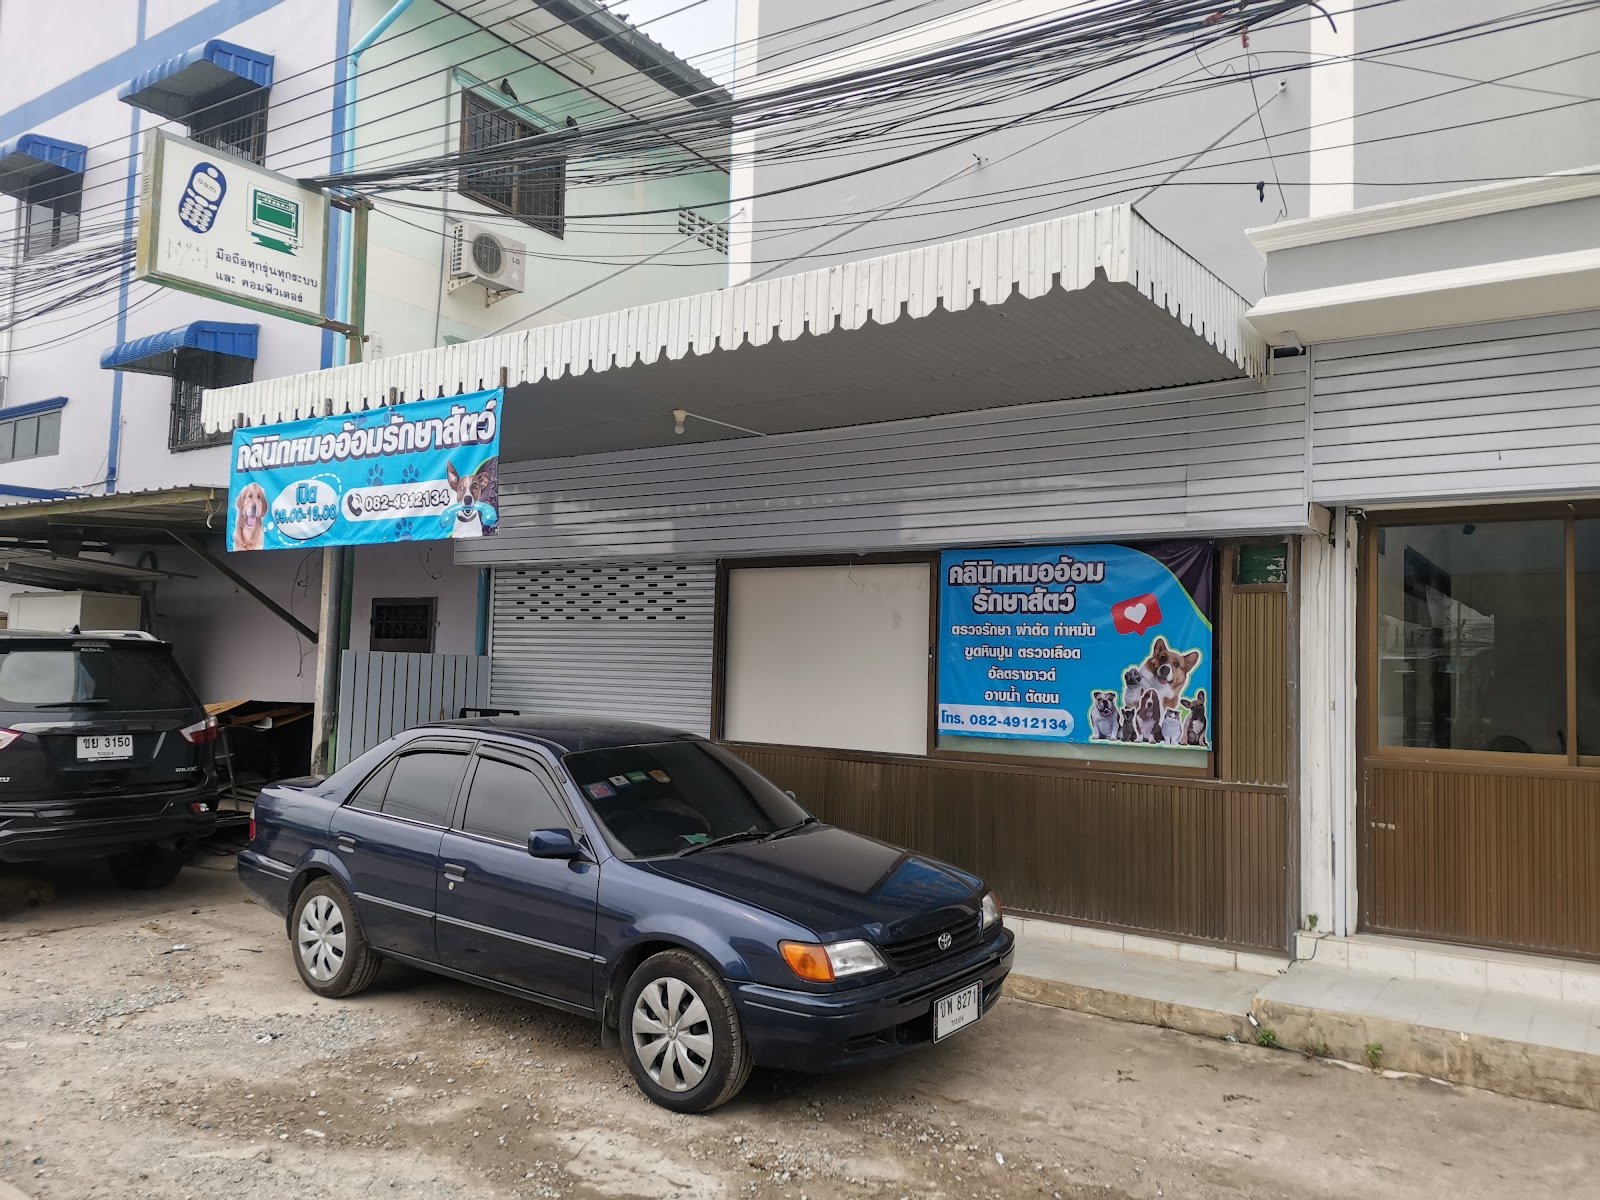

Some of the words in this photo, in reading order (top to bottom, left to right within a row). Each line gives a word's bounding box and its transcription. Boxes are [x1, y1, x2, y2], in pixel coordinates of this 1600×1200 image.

[215, 247, 318, 288] มือถือทุกรุ่นทุกระบบ
[215, 271, 236, 285] และ
[236, 398, 497, 473] คลินิกหมออ้อมรักษาสัตว์
[296, 482, 318, 505] เปิด
[363, 488, 451, 512] 082-4912134
[948, 555, 1105, 586] คลินิกหมออ้อม
[973, 586, 1076, 615] รักษาสัตว์
[951, 624, 1012, 637] ตรวจรักษา
[1016, 623, 1049, 637] ผ่าตัด
[1054, 622, 1097, 637] ทำหมัน
[964, 646, 1013, 662] ขูดหินปูน
[1017, 645, 1081, 660] ตรวจเลือด
[987, 665, 1056, 681] อัลตราซาวด์
[984, 686, 1021, 704] อาบน้ำ
[1025, 691, 1059, 704] ตัดขน
[941, 709, 964, 726] โทร.
[969, 714, 1068, 731] 082-4912134
[104, 737, 131, 748] 3150
[957, 988, 976, 1010] 8271
